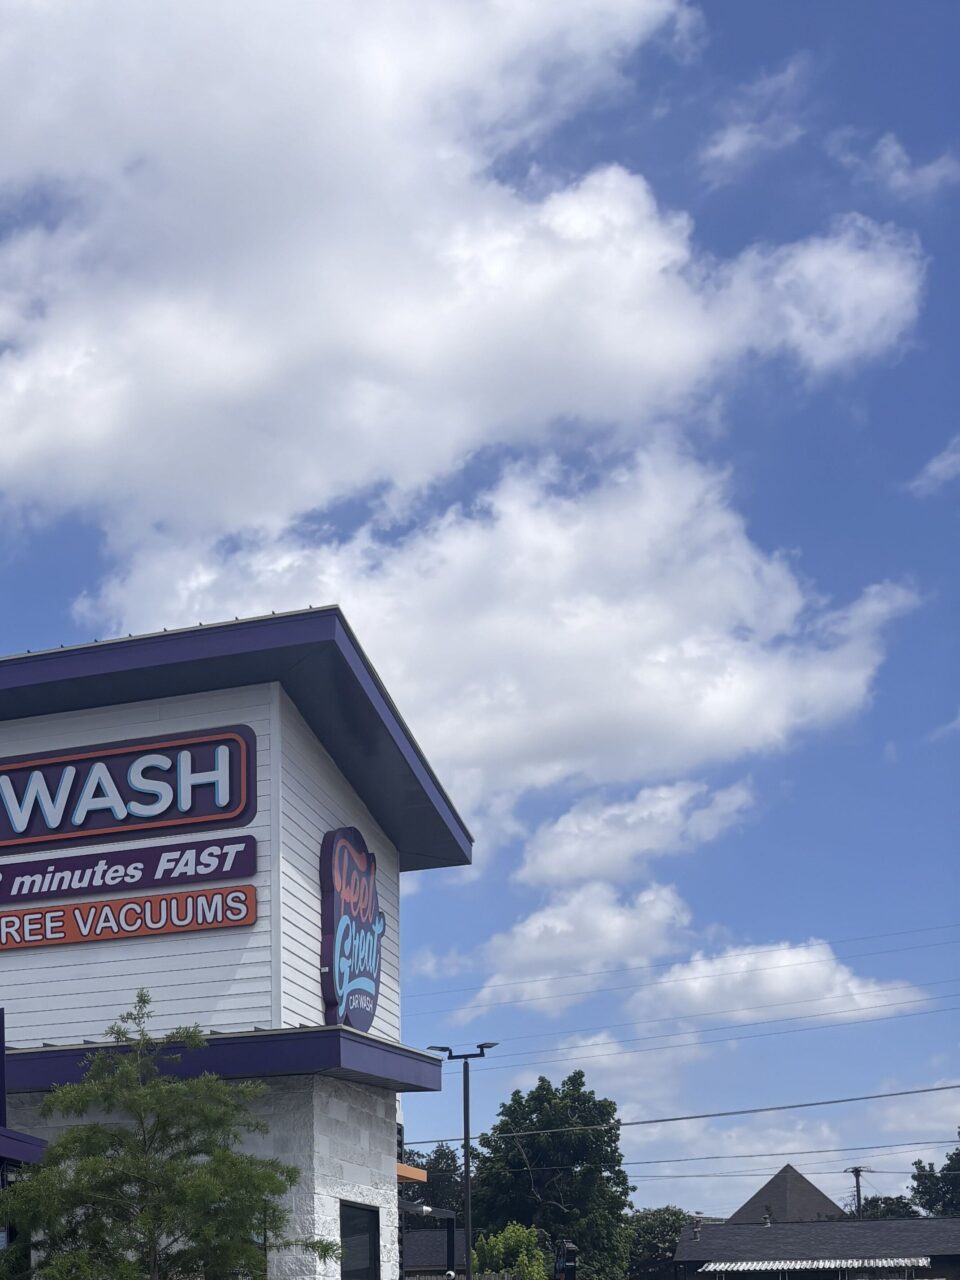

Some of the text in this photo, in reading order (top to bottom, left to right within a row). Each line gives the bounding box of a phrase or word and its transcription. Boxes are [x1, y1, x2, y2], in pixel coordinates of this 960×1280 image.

[10, 859, 144, 896] minutes
[154, 843, 246, 880] FAST
[332, 838, 376, 923] Feel
[73, 890, 248, 936] VACUUMS
[335, 914, 384, 1017] Great
[349, 994, 374, 1014] CAR WASH
